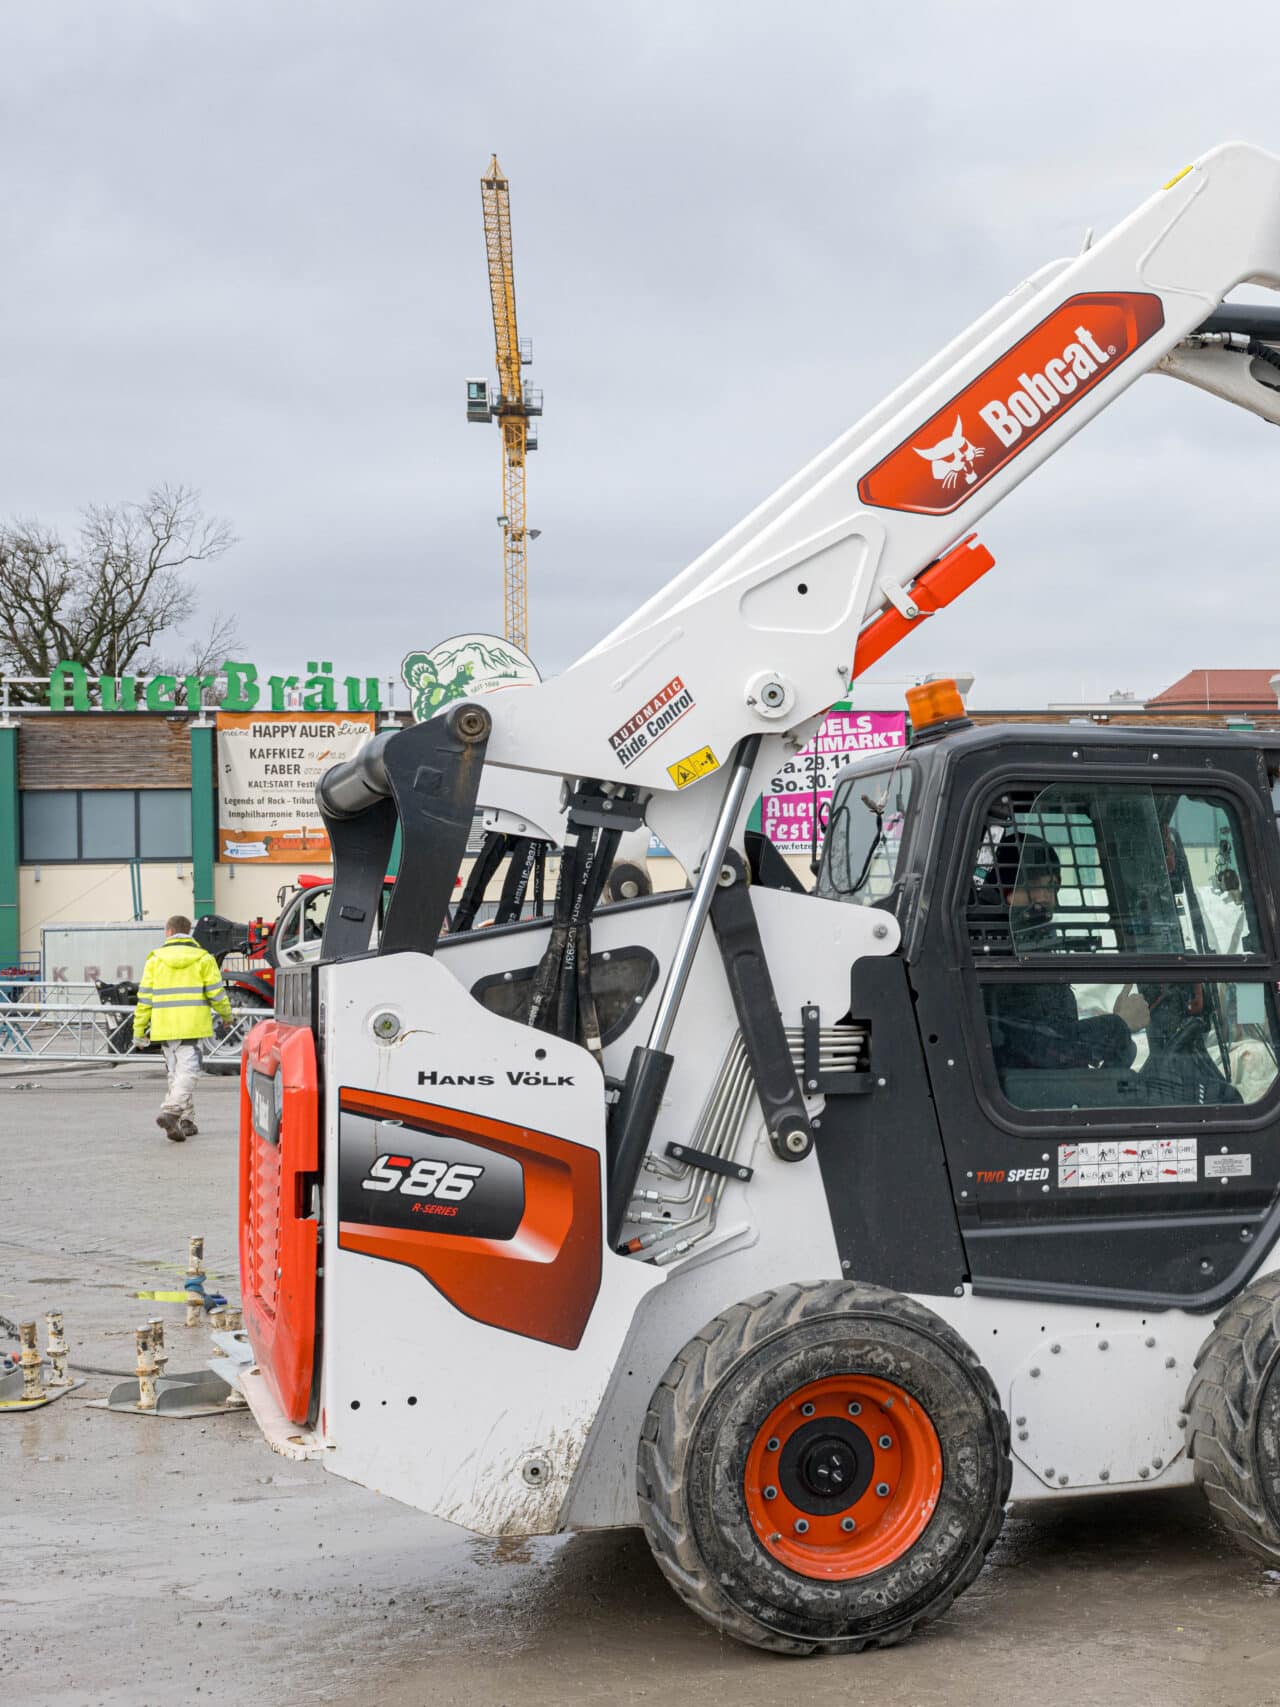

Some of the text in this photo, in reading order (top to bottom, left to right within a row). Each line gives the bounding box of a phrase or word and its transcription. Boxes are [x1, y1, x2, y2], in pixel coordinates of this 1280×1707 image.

[978, 325, 1111, 448] Bobcat
[611, 679, 682, 748] AUTOMATIC
[252, 725, 296, 738] HAPPY
[300, 725, 335, 738] AUER
[616, 688, 694, 766] Ride Control
[249, 748, 305, 760] KAFFKIEZ
[264, 763, 301, 775] FABER
[224, 797, 255, 807] Legends
[257, 796, 266, 805] of
[267, 796, 286, 805] Rock
[292, 796, 318, 805] Tribut
[228, 810, 293, 819] Innphilharmonie
[417, 1070, 576, 1087] HANS VÖLK
[361, 1154, 485, 1201] S86
[976, 1167, 1050, 1184] TWO SPEED
[411, 1202, 459, 1217] R-SERIES
